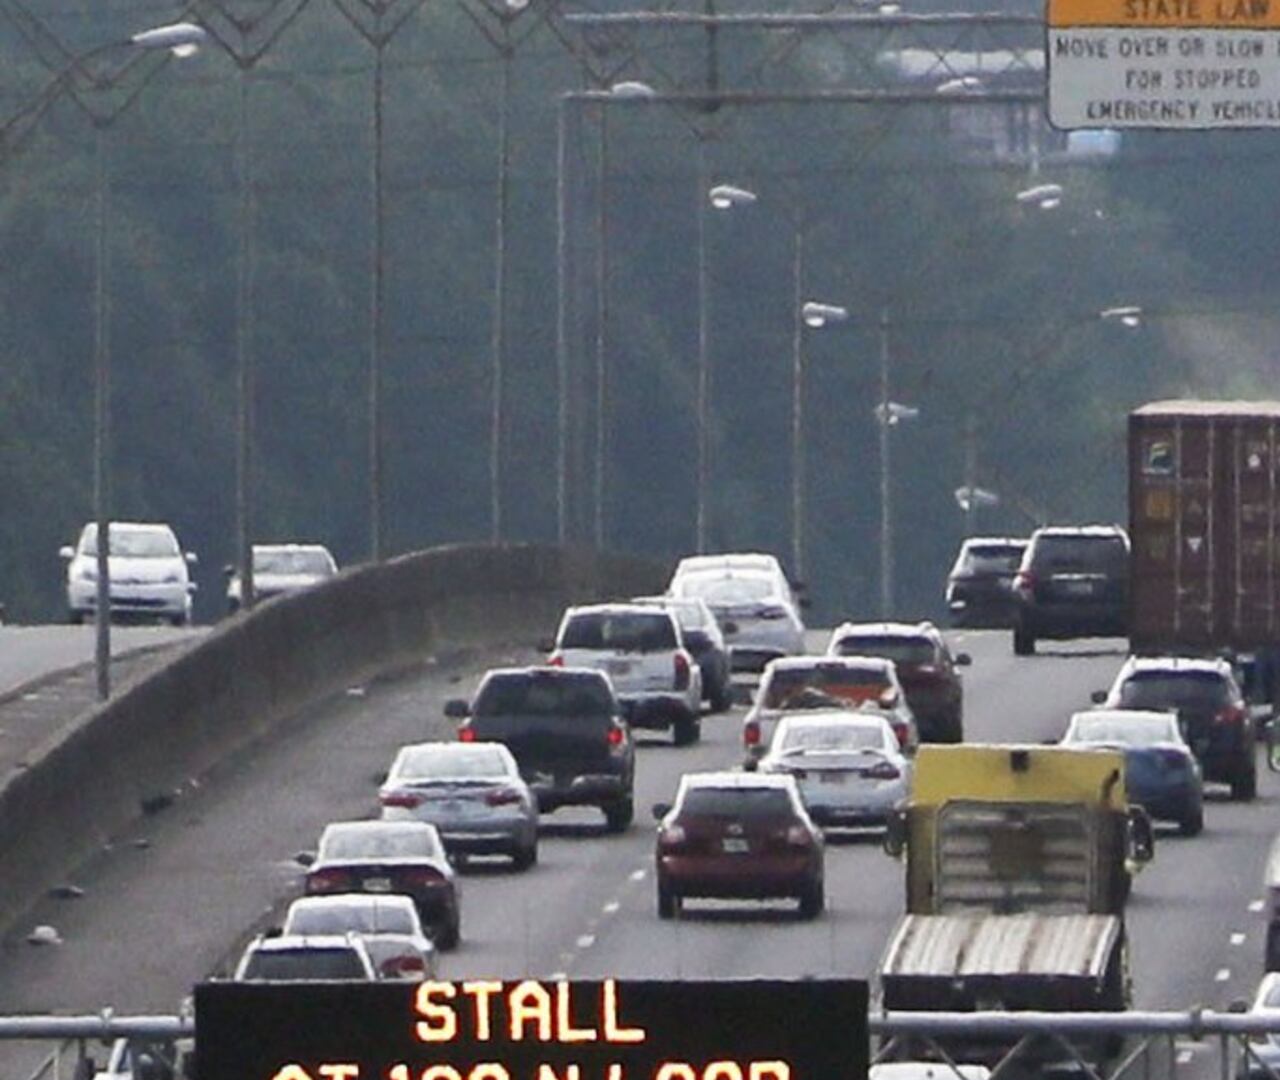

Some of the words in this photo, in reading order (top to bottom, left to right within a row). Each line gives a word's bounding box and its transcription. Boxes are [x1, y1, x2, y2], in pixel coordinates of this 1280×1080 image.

[1125, 0, 1198, 19] STATE
[1216, 0, 1270, 19] LAW
[1056, 37, 1108, 59] MOVE
[1119, 37, 1169, 58] OVER
[1179, 38, 1204, 57] OR
[1216, 39, 1263, 58] SLOW
[1125, 69, 1162, 89] FOR
[1175, 69, 1260, 89] STOPPED
[1086, 100, 1198, 120] EMERGENCY
[415, 980, 646, 1043] STALL
